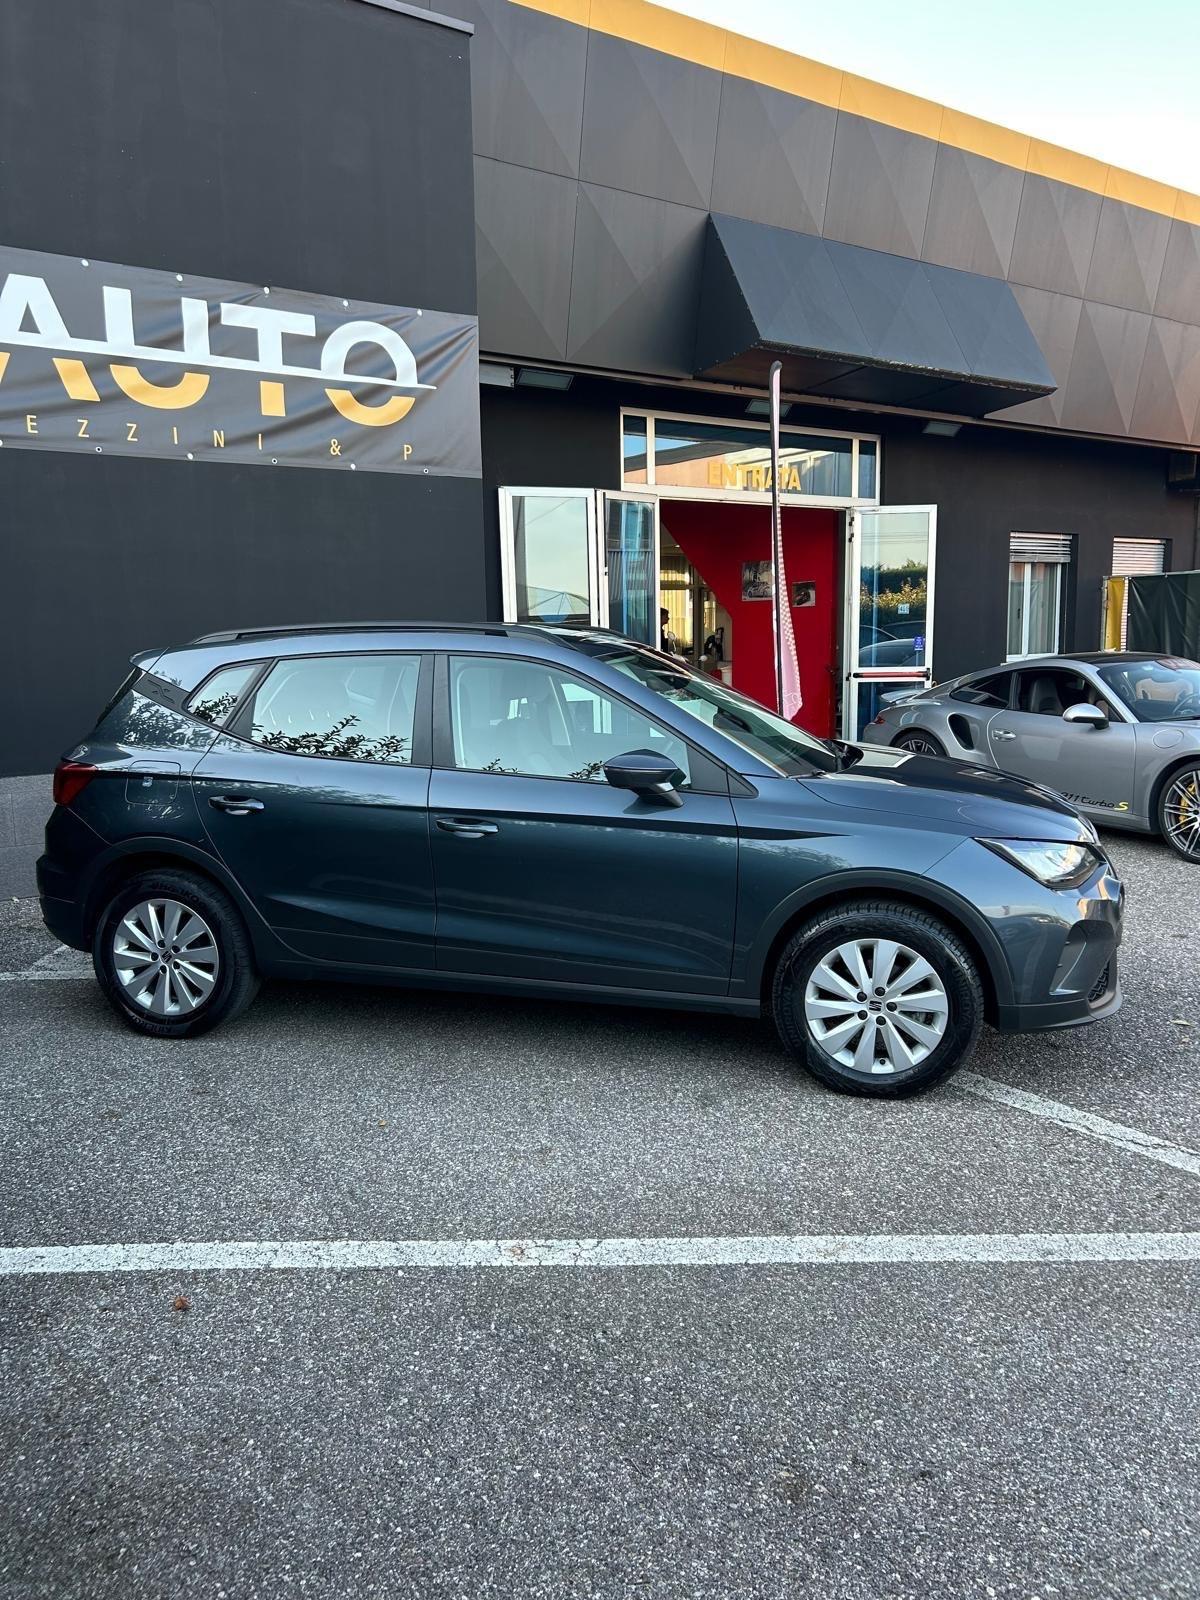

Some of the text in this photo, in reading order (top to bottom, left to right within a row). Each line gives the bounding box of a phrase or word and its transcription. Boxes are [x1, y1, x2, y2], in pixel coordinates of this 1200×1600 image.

[0, 273, 417, 427] AUTO
[330, 439, 342, 456] &
[1113, 801, 1129, 811] S
